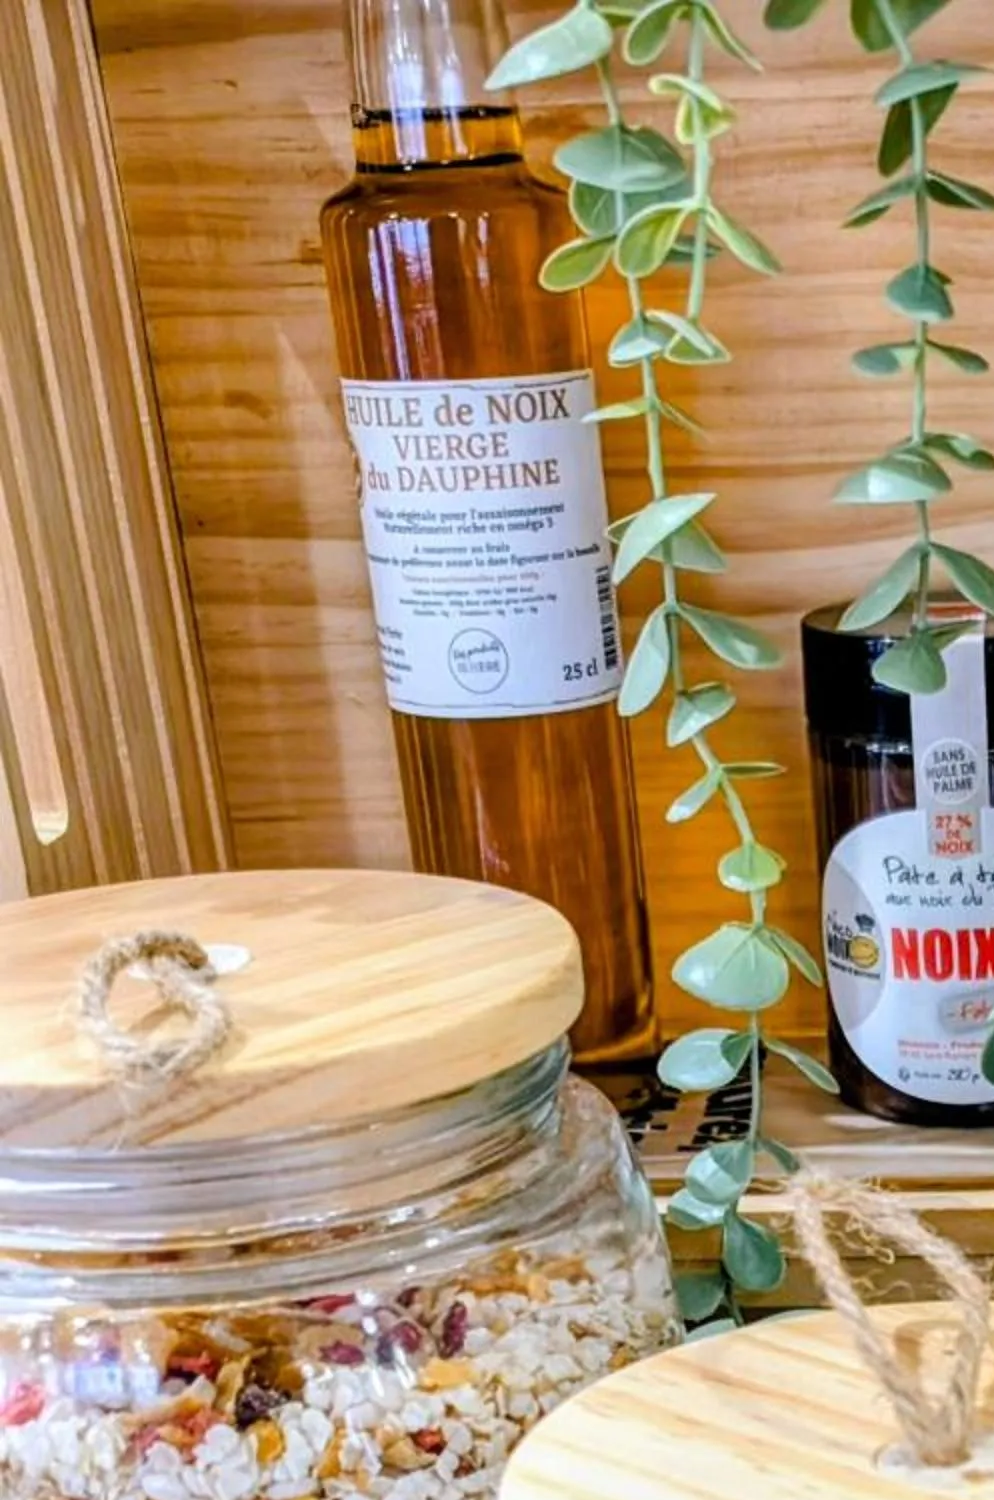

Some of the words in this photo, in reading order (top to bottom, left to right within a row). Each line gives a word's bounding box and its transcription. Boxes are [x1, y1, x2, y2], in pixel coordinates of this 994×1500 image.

[347, 395, 424, 427] HUILE
[434, 394, 474, 427] de
[486, 388, 571, 425] NOIX
[392, 432, 509, 461] VIERGE
[367, 463, 390, 491] du
[397, 459, 560, 492] DAUPHINE
[563, 662, 583, 681] 25
[587, 657, 599, 677] cl
[933, 748, 965, 762] SANS
[926, 764, 957, 778] HUILE
[960, 761, 976, 775] DE
[933, 778, 973, 792] PALME
[935, 815, 952, 829] 27
[935, 841, 973, 854] NOIX
